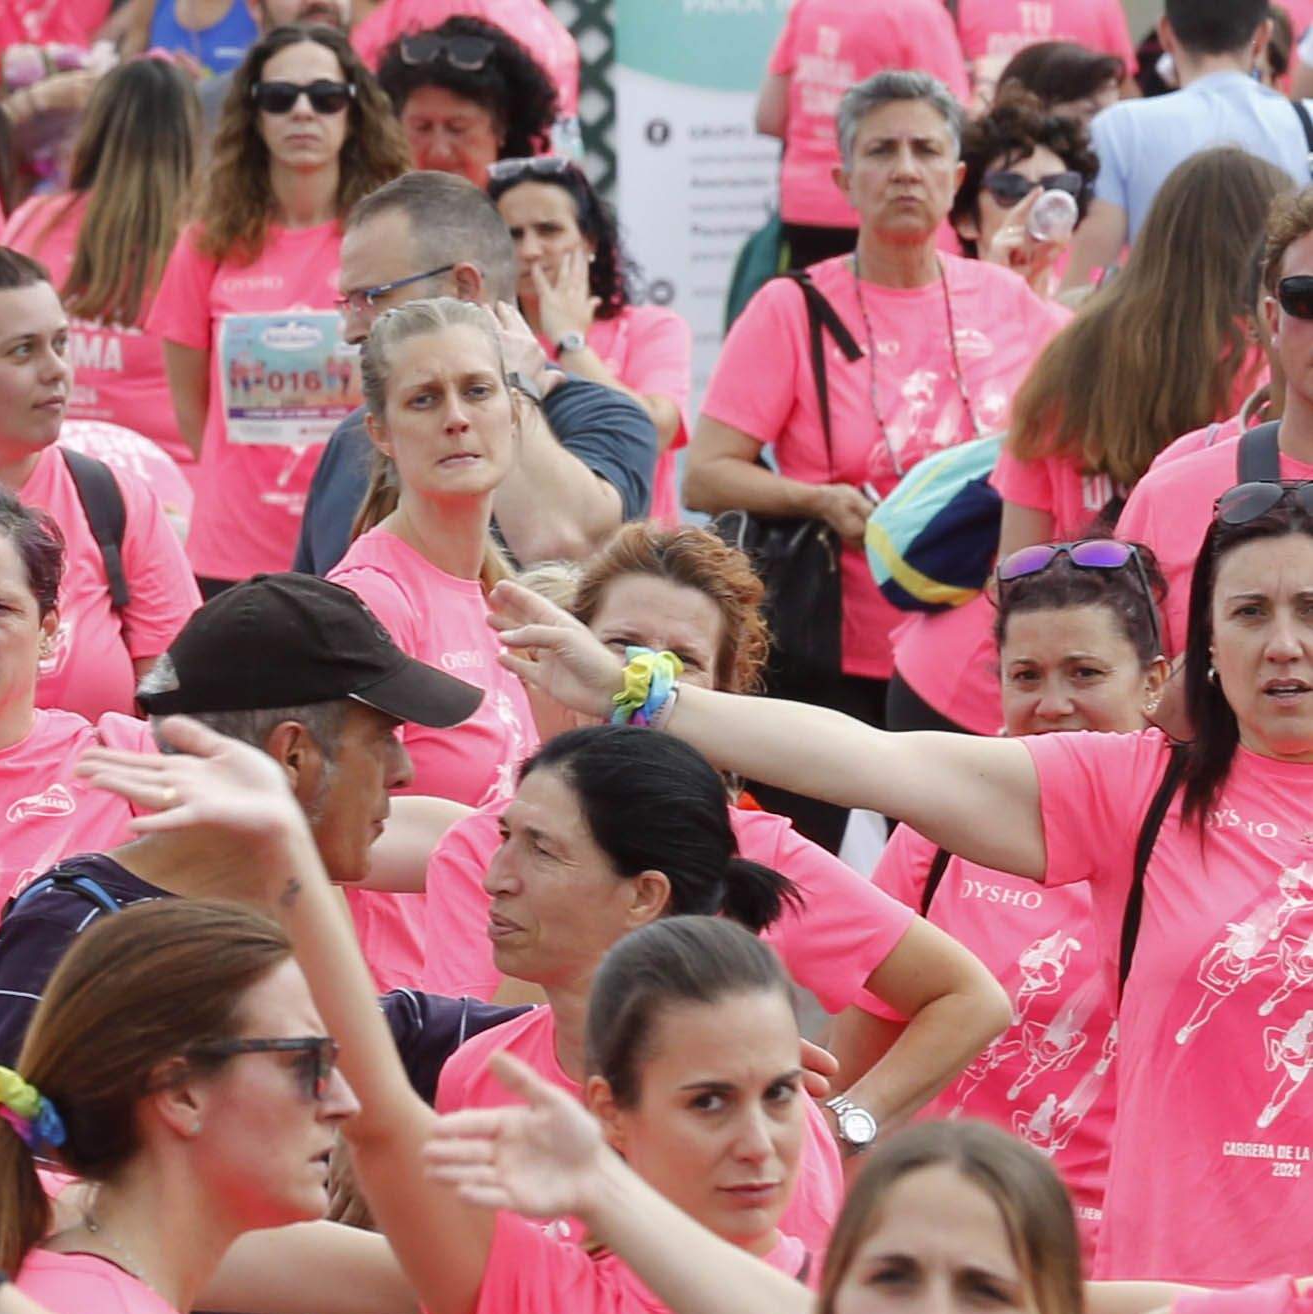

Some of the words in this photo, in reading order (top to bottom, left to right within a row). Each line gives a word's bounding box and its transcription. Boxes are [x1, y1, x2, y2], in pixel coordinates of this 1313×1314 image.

[267, 370, 323, 392] 016
[1222, 1141, 1275, 1159] CARRERA
[1276, 1145, 1294, 1160] DE
[1295, 1146, 1311, 1161] LA
[1271, 1161, 1302, 1178] 2024
